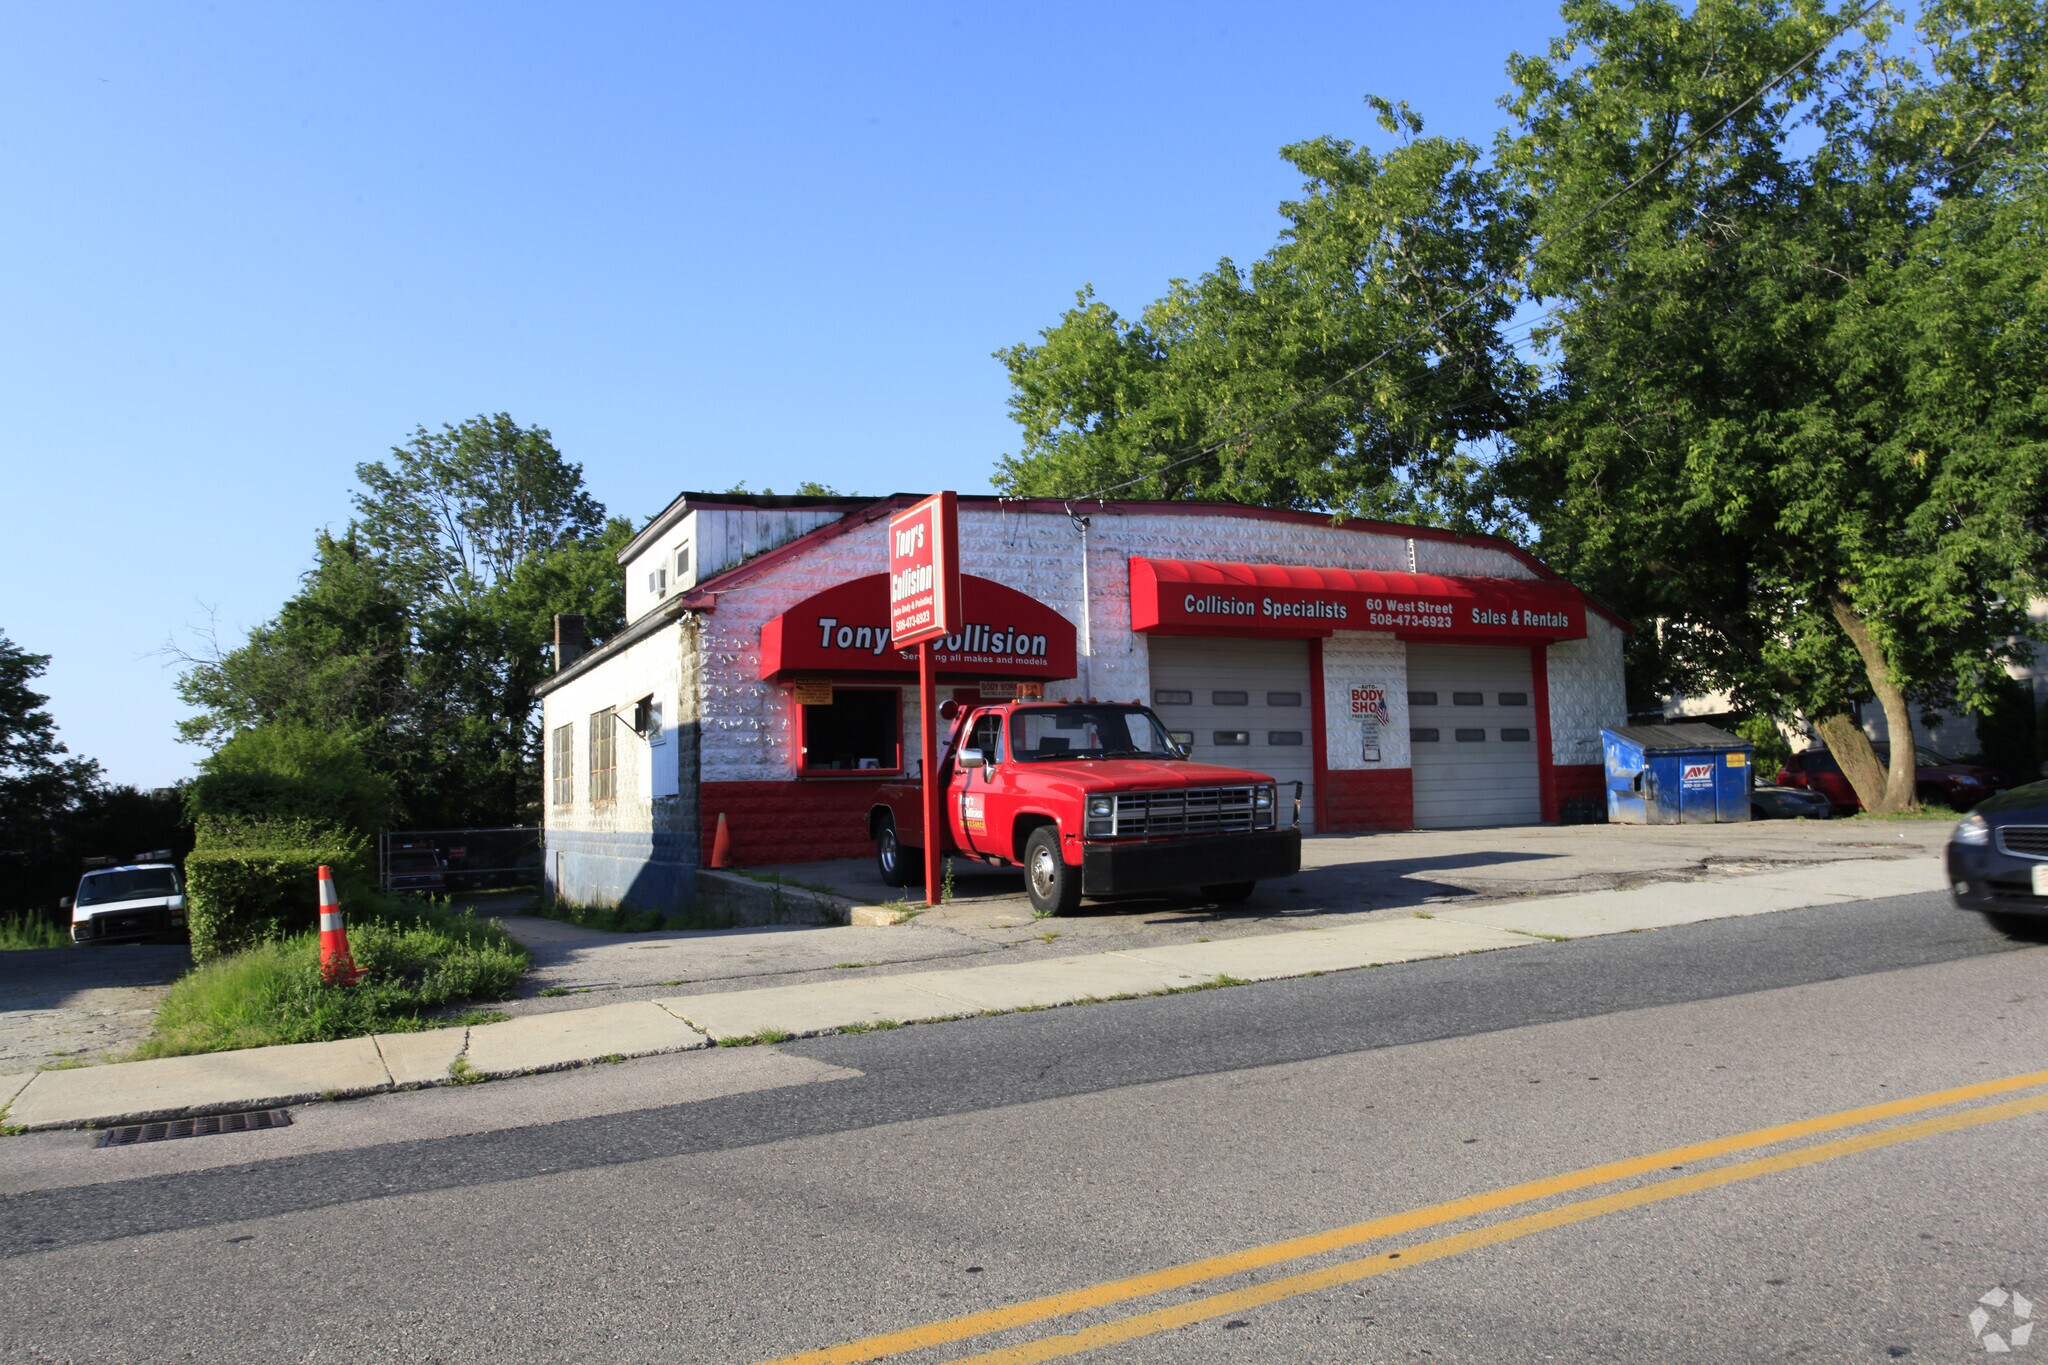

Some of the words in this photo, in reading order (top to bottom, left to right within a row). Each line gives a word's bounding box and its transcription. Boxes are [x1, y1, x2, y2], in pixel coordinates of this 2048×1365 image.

[895, 523, 924, 559] Tony's
[892, 564, 932, 603] Collision
[1183, 594, 1255, 616] Collision
[1262, 597, 1348, 620] Specialists
[1366, 598, 1383, 611] 60
[1386, 599, 1415, 613] West
[1417, 601, 1453, 615] Street
[1369, 613, 1452, 628] 508-473-6923
[1471, 607, 1507, 626] Sales
[1511, 609, 1520, 626] &
[1523, 609, 1569, 628] Rentals
[818, 617, 890, 656] Tony
[902, 652, 947, 663] Serng
[949, 654, 961, 662] all
[964, 655, 993, 663] makes
[996, 656, 1013, 664] and
[1015, 657, 1048, 666] models
[981, 683, 999, 691] BODY
[1352, 690, 1384, 701] BODY
[1351, 702, 1377, 713] SHO
